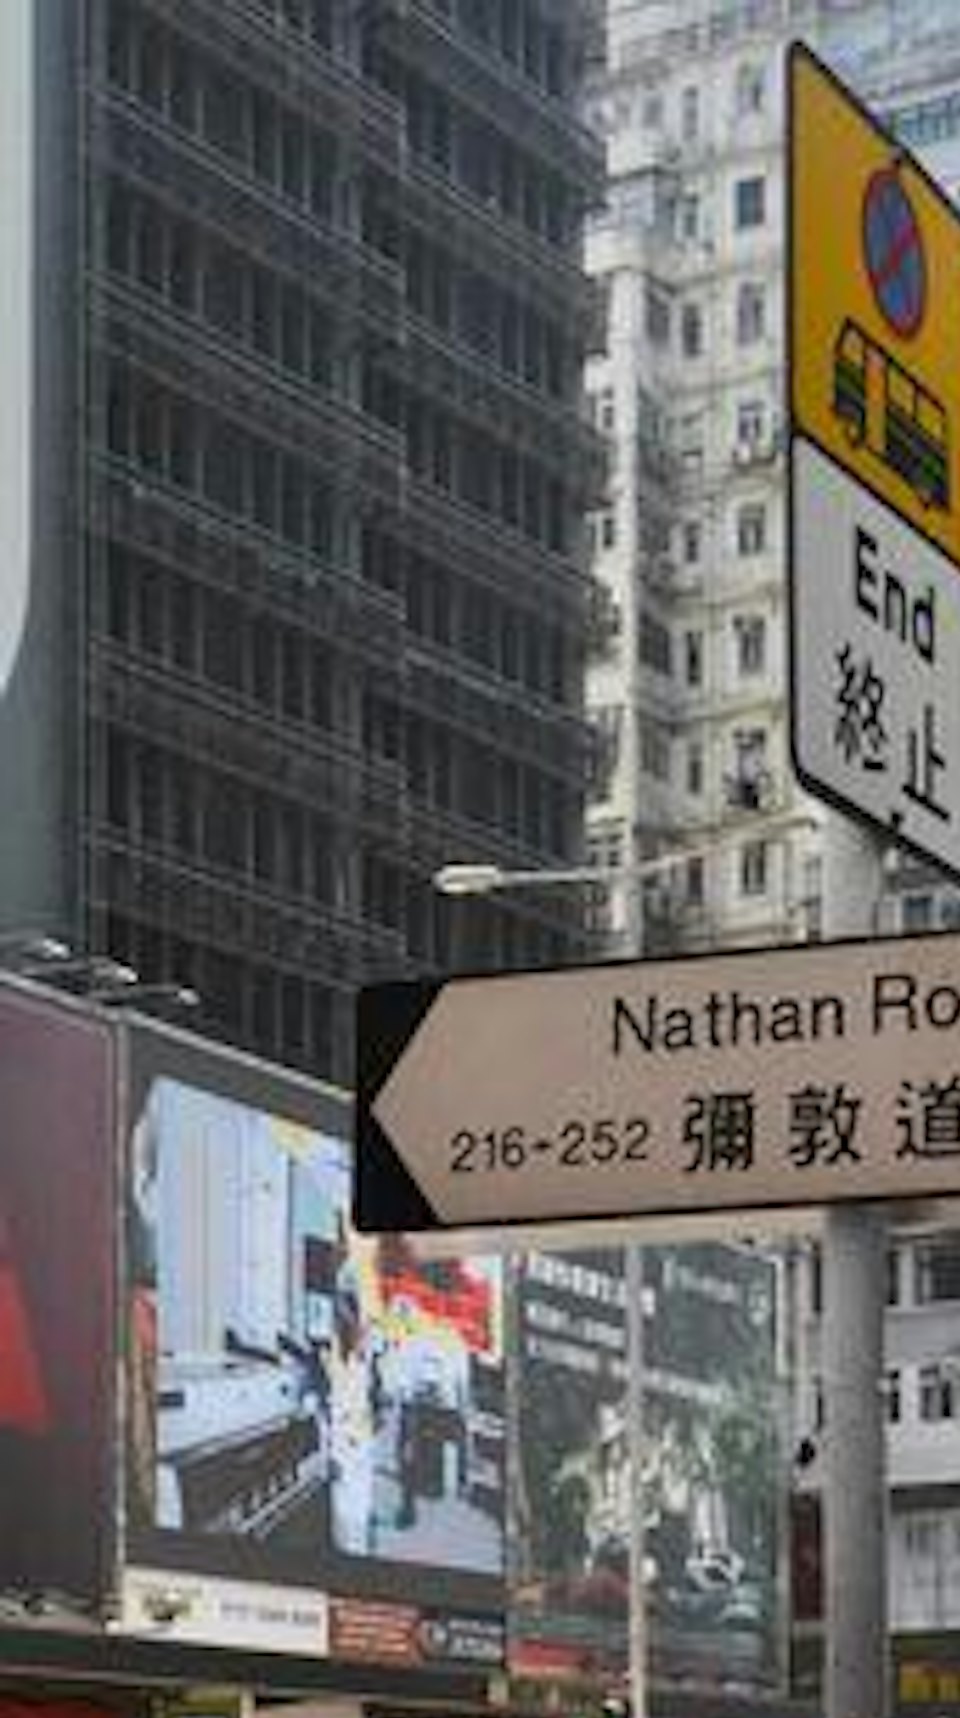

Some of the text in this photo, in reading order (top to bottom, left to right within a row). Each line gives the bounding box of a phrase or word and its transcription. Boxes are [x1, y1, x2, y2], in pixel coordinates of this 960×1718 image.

[854, 525, 936, 666] End
[833, 641, 951, 823] 終止
[611, 990, 845, 1057] Nathan
[449, 1117, 651, 1174] 216-252
